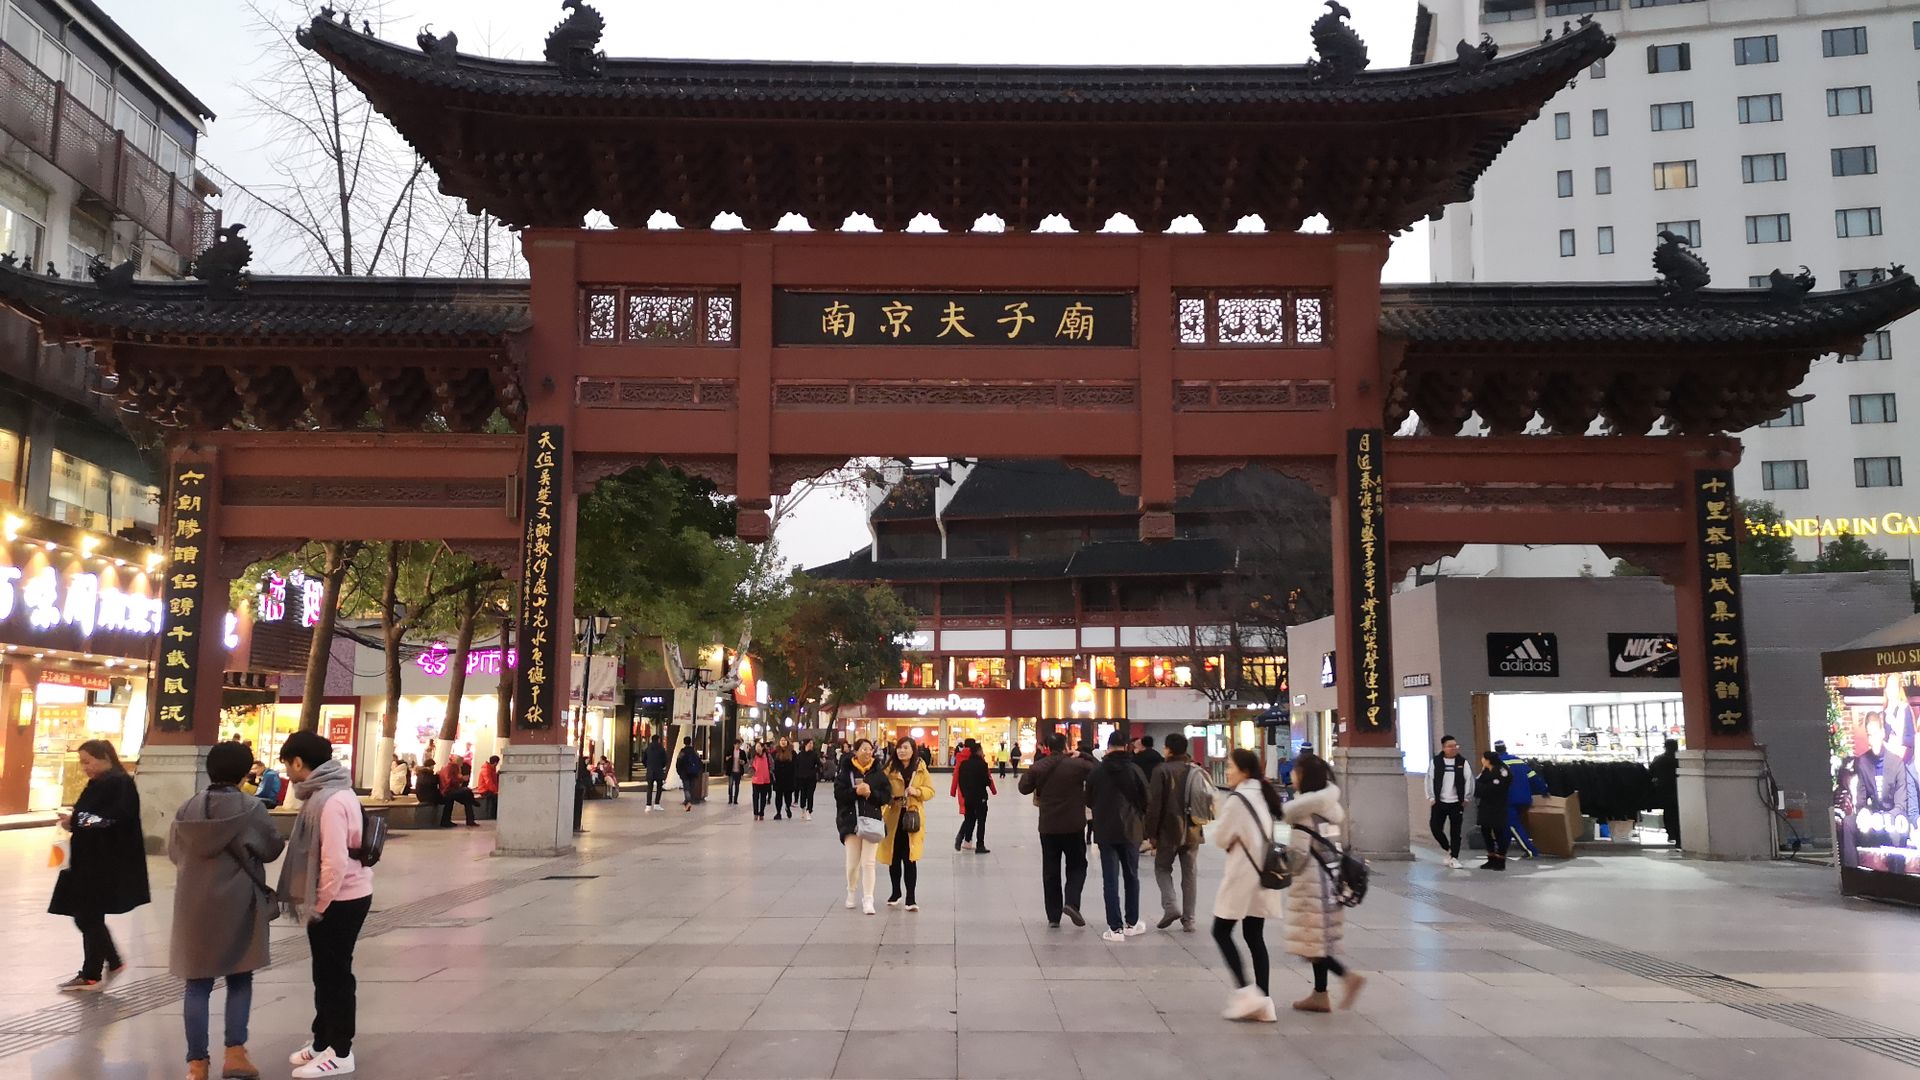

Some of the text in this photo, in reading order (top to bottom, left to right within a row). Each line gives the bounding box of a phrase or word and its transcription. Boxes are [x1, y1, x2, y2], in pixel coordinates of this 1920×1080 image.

[821, 300, 1095, 341] 南京夫子廟
[1881, 512, 1920, 535] GA
[1624, 638, 1662, 657] NIKE
[1500, 659, 1551, 672] adidas
[1876, 650, 1906, 666] POLO
